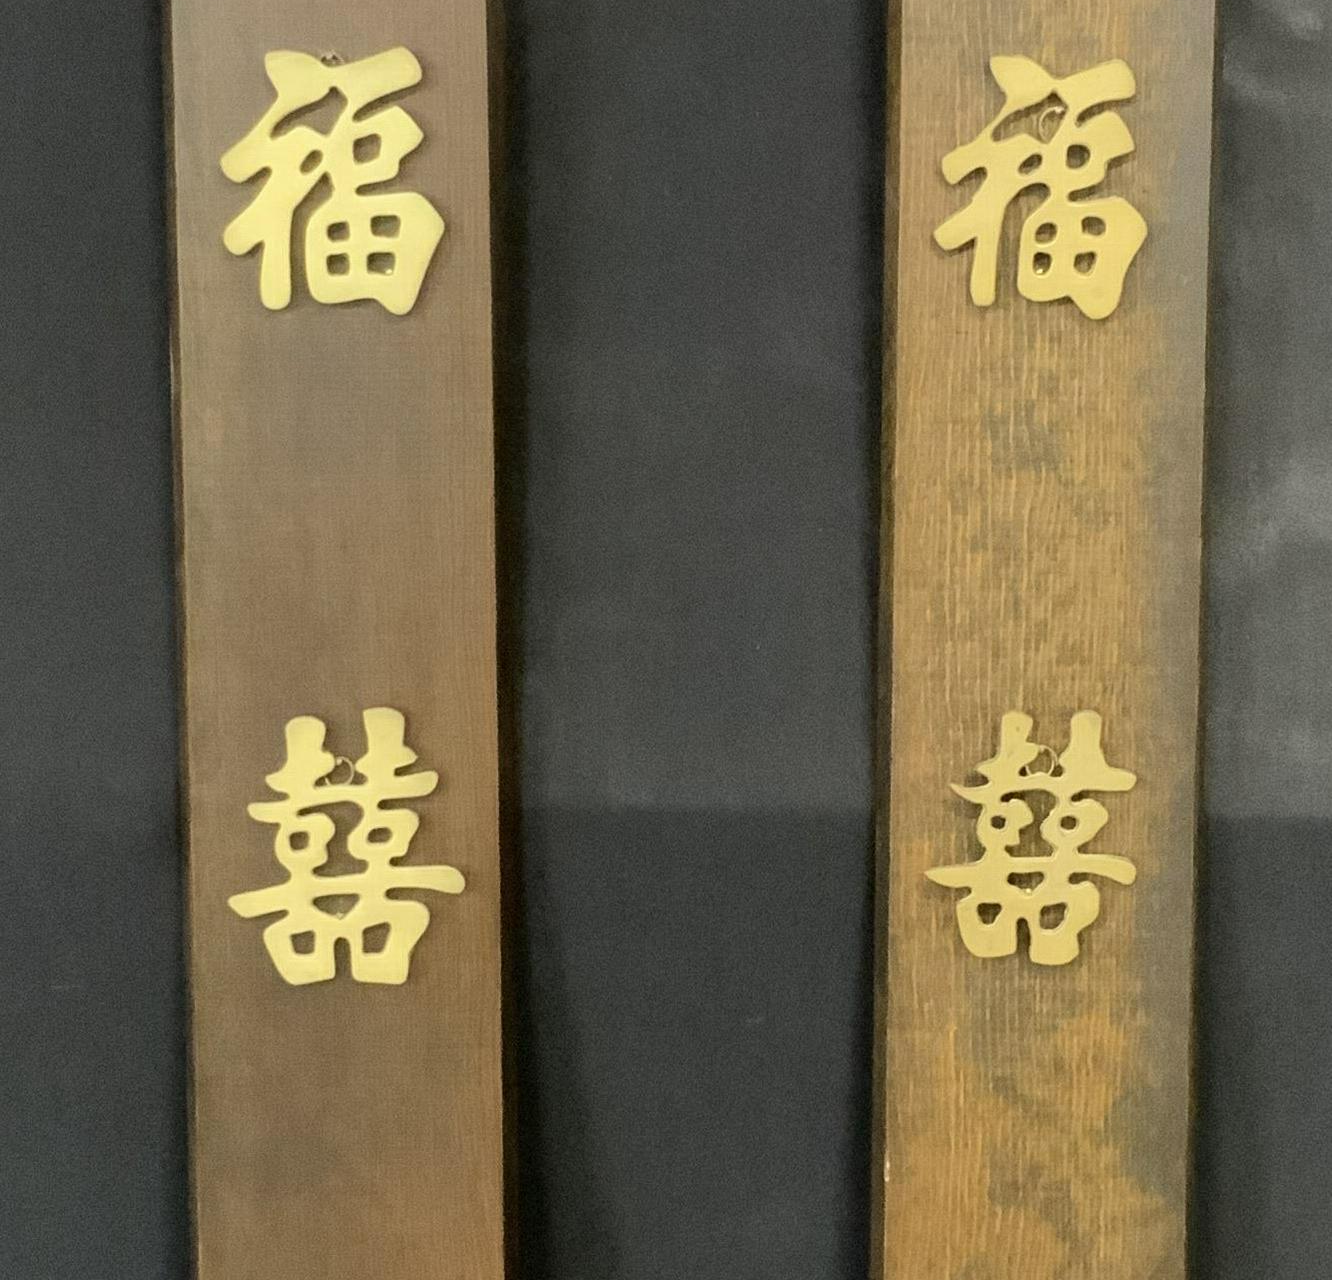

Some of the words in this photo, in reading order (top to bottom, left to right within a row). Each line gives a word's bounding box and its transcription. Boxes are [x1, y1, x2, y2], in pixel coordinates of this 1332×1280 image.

[220, 46, 446, 316] 福
[932, 54, 1149, 320] 福
[228, 706, 466, 986] 囍
[924, 709, 1138, 966] 囍
